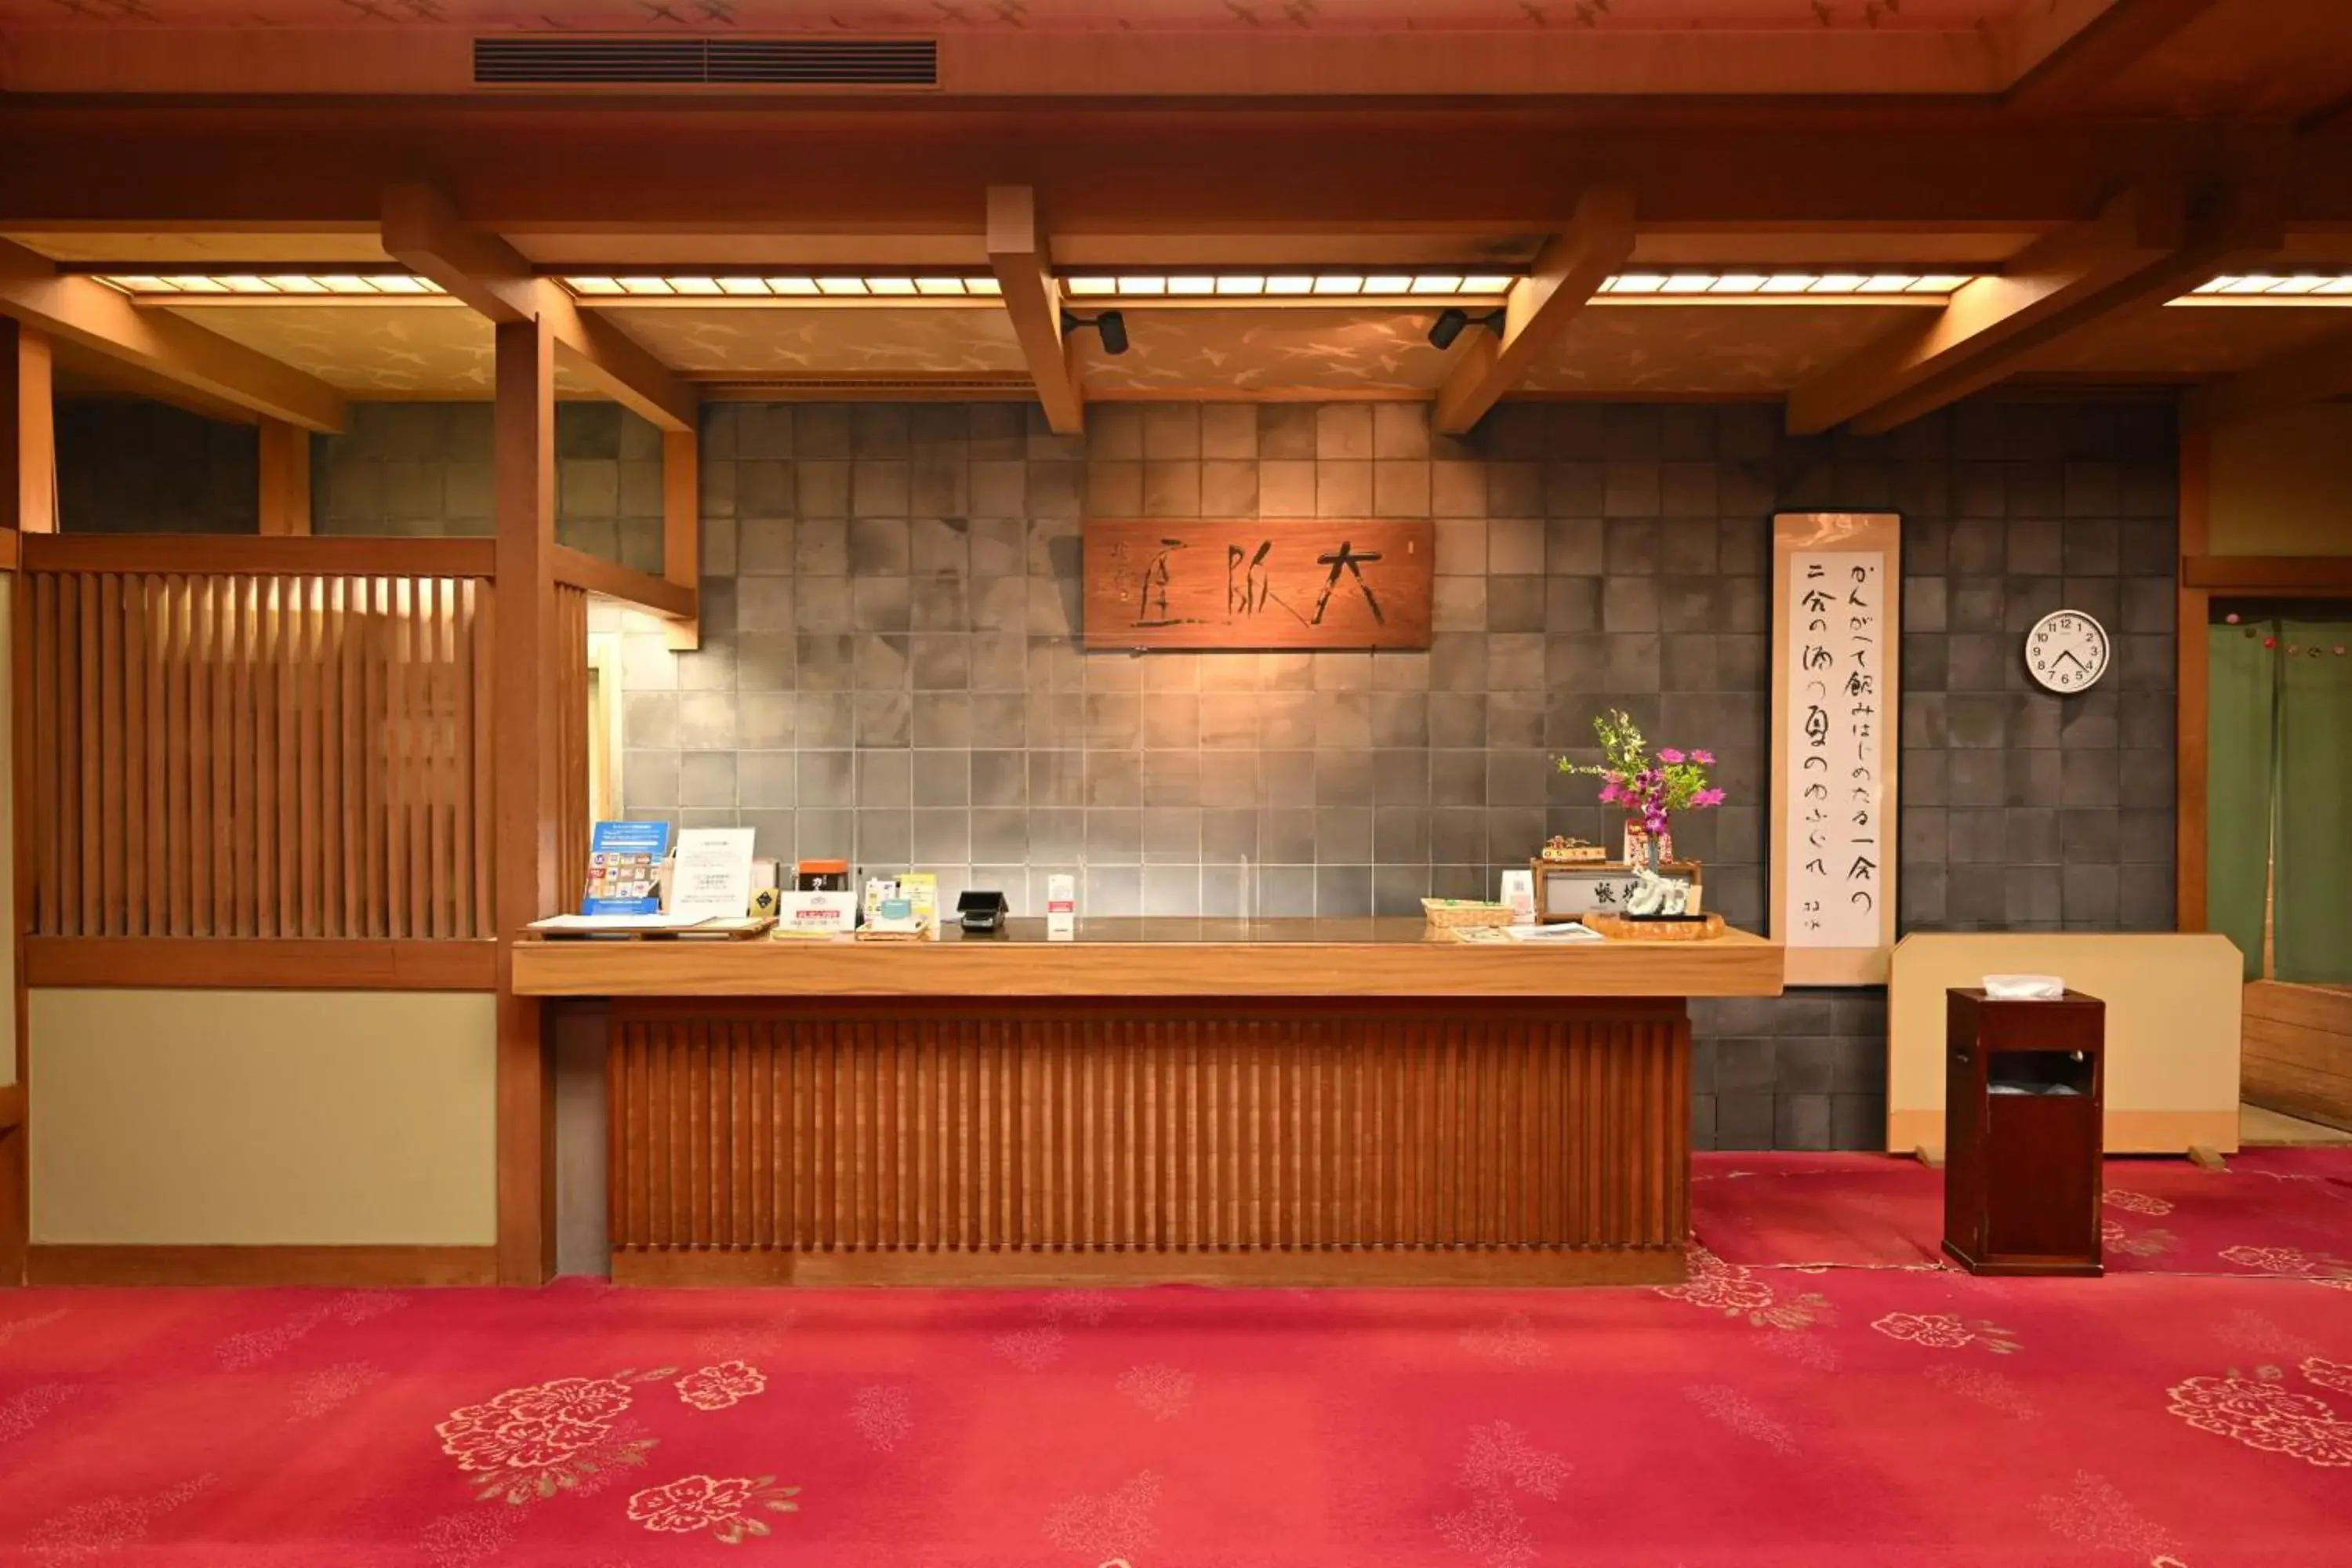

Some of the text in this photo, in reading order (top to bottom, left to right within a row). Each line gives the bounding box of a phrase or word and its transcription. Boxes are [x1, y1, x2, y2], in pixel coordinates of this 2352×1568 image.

[2049, 622, 2056, 632] 11
[2060, 619, 2071, 629] 12
[2077, 622, 2082, 632] 1
[2037, 633, 2048, 643] 10
[2085, 633, 2093, 642] 2
[2033, 647, 2041, 656] 9
[2090, 647, 2098, 656] 3
[2038, 660, 2045, 670] 8
[2085, 660, 2093, 670] 4
[2049, 670, 2056, 680] 7
[2061, 673, 2069, 684] 6
[2075, 670, 2083, 680] 5
